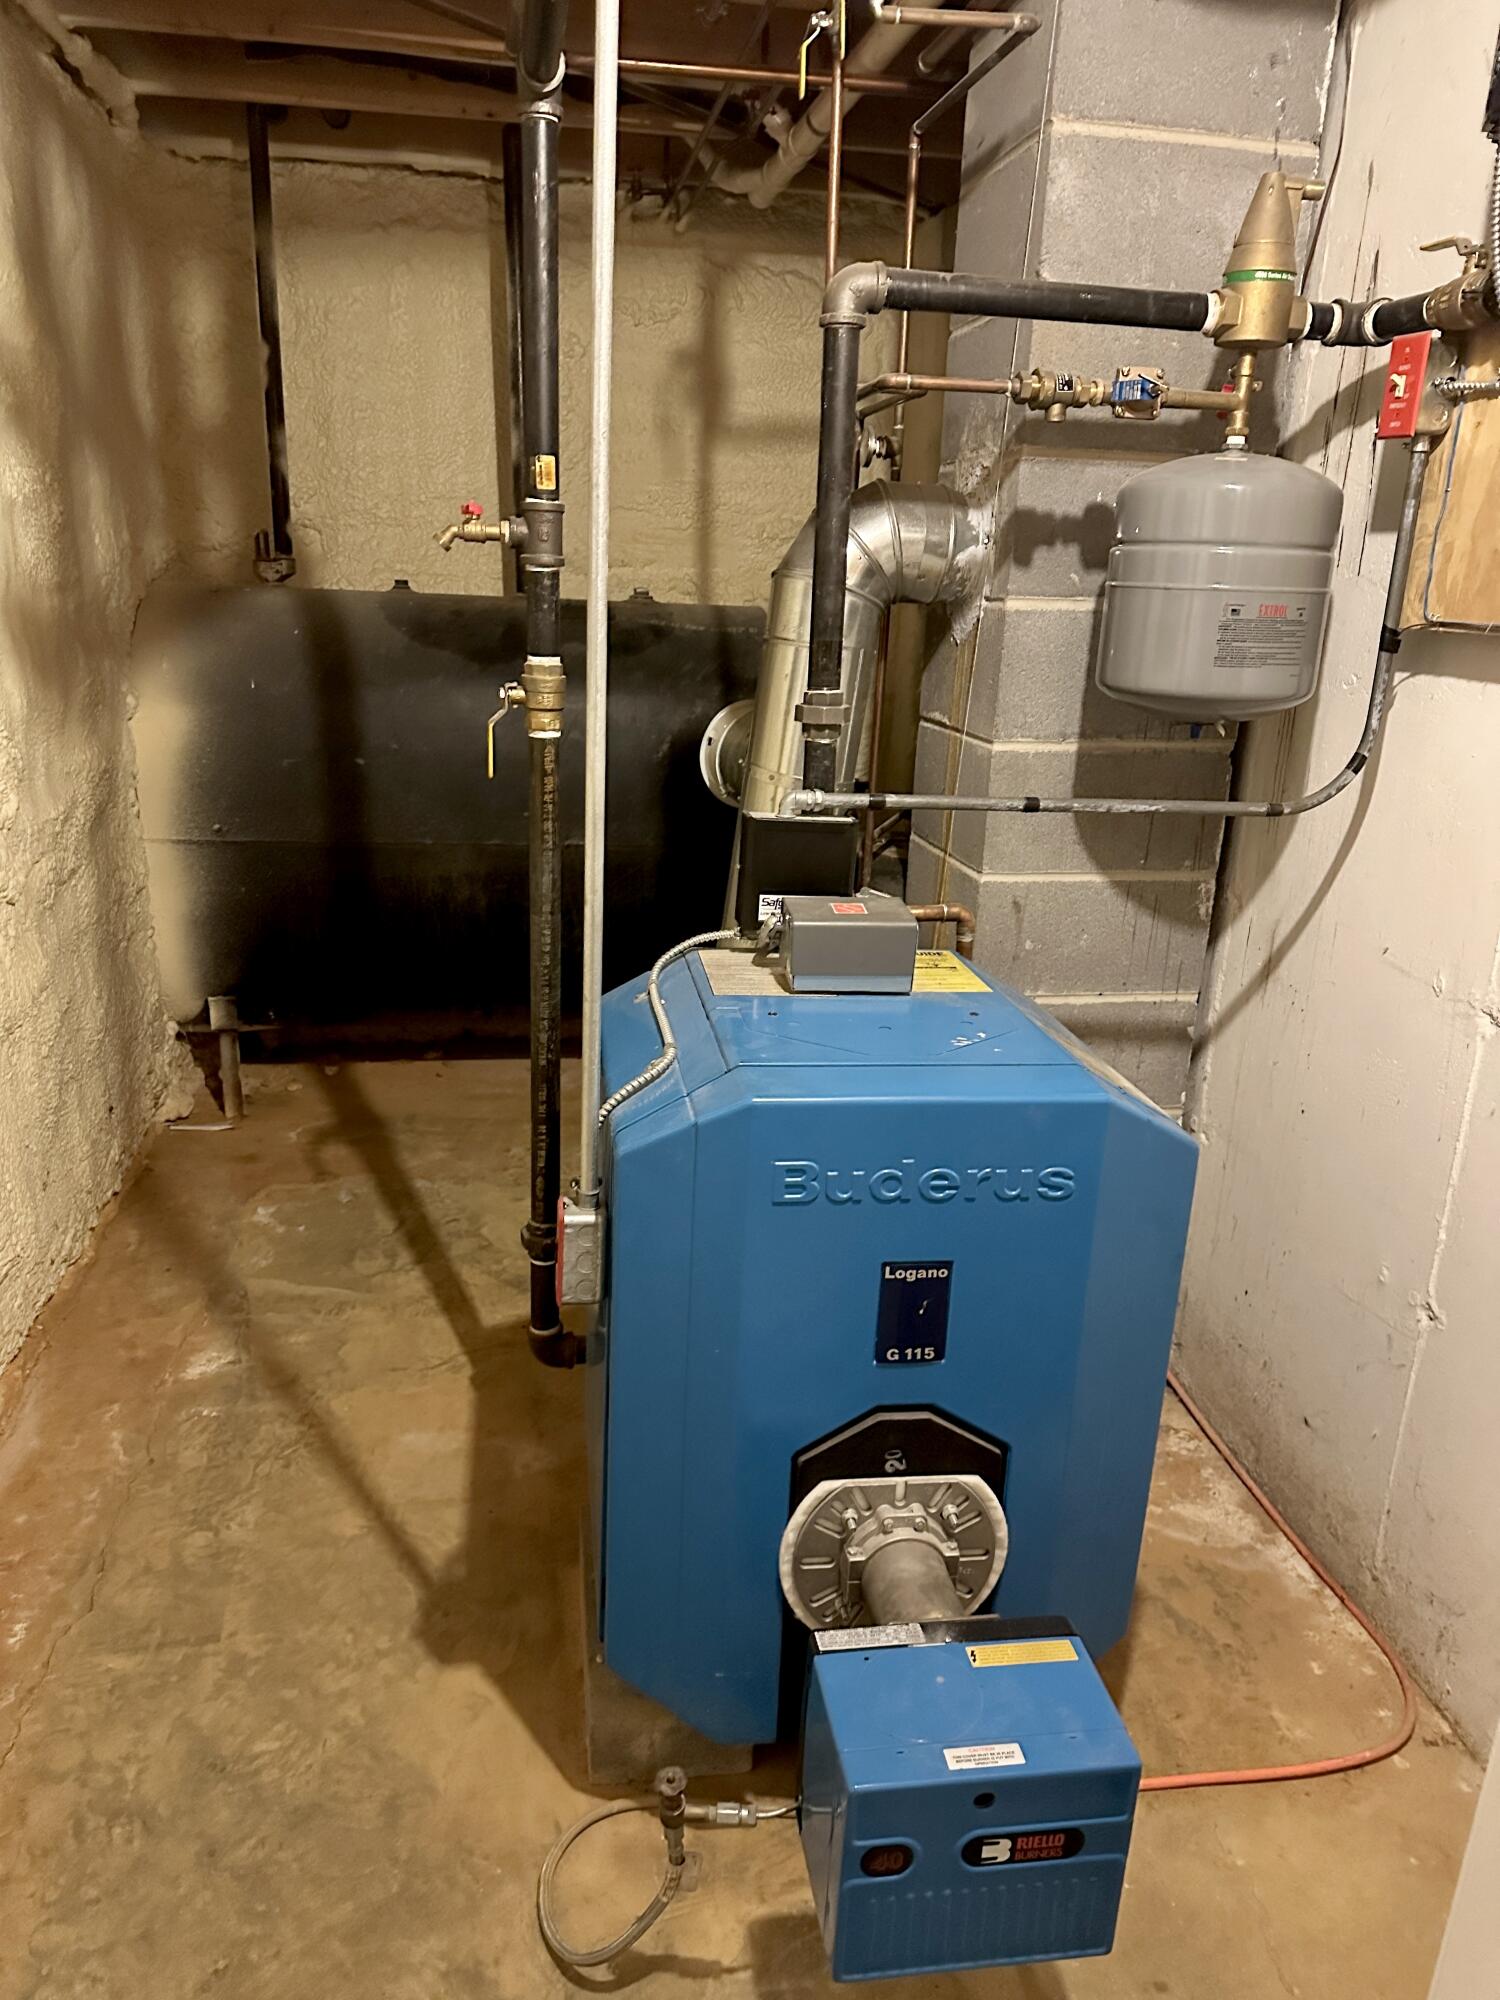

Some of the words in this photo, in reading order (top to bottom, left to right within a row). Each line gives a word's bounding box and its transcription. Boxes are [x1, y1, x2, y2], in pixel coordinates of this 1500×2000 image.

[772, 1159, 1075, 1205] Buderus
[884, 1266, 949, 1281] Logano
[886, 1348, 899, 1361] G
[904, 1347, 935, 1360] 115
[1016, 1833, 1065, 1850] RIELLO
[1014, 1847, 1063, 1861] BURNERS
